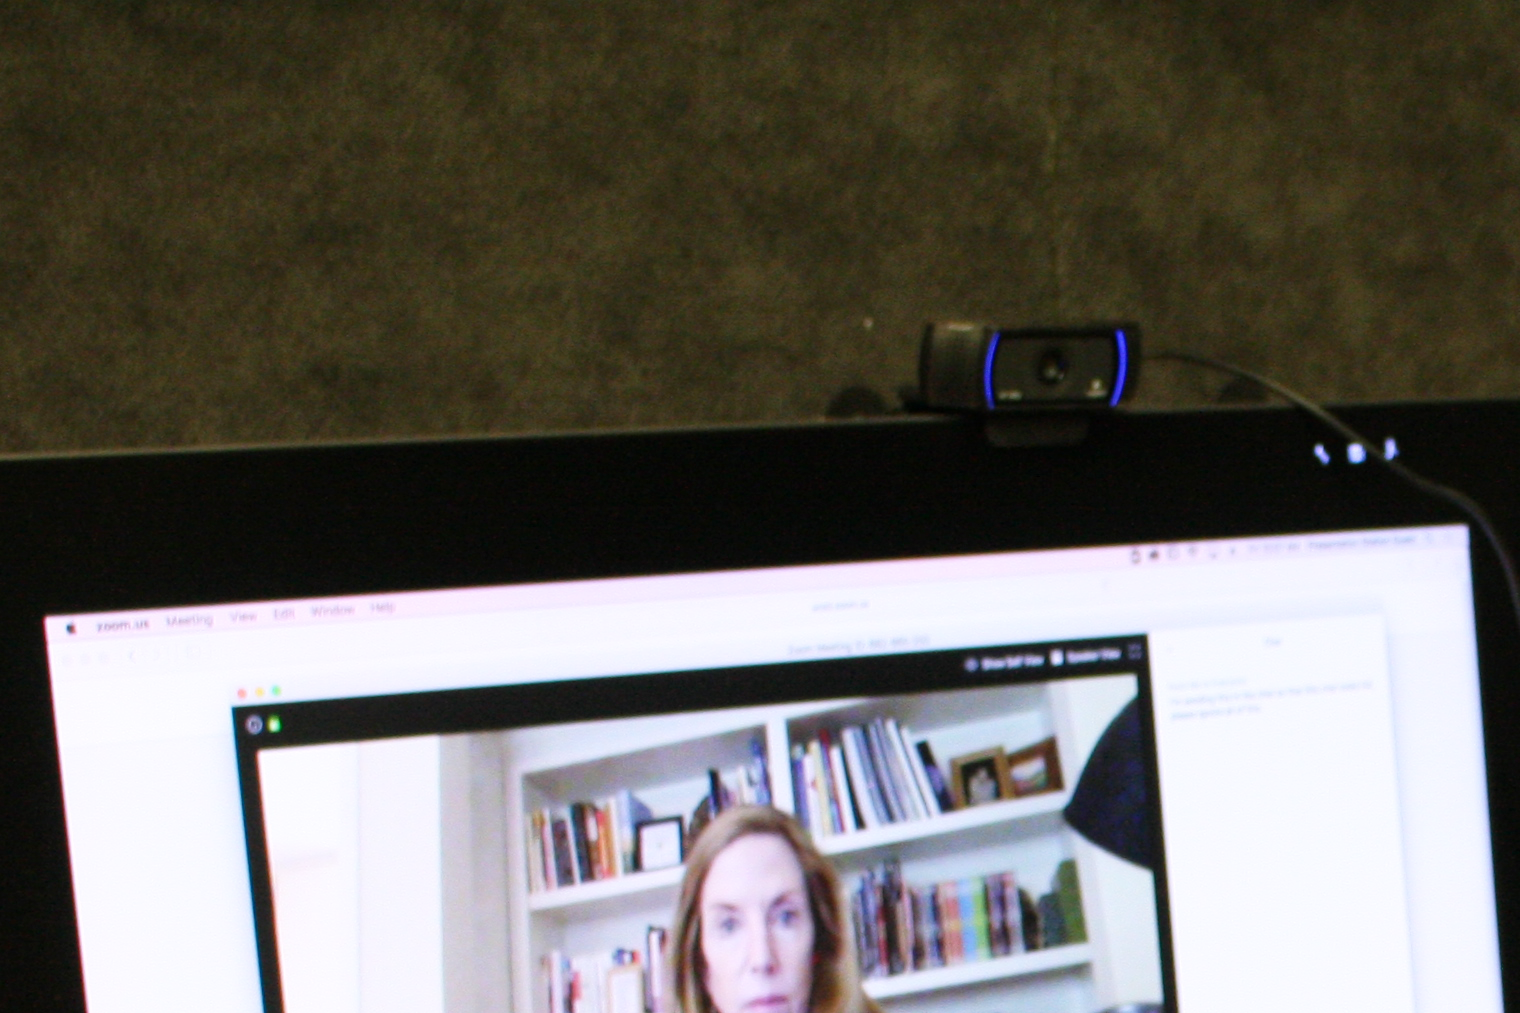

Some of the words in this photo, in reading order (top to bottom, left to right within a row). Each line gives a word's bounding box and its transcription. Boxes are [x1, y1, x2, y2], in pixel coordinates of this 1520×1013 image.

[97, 618, 150, 633] zoom.us
[166, 613, 213, 628] Meeting
[310, 604, 355, 617] Window
